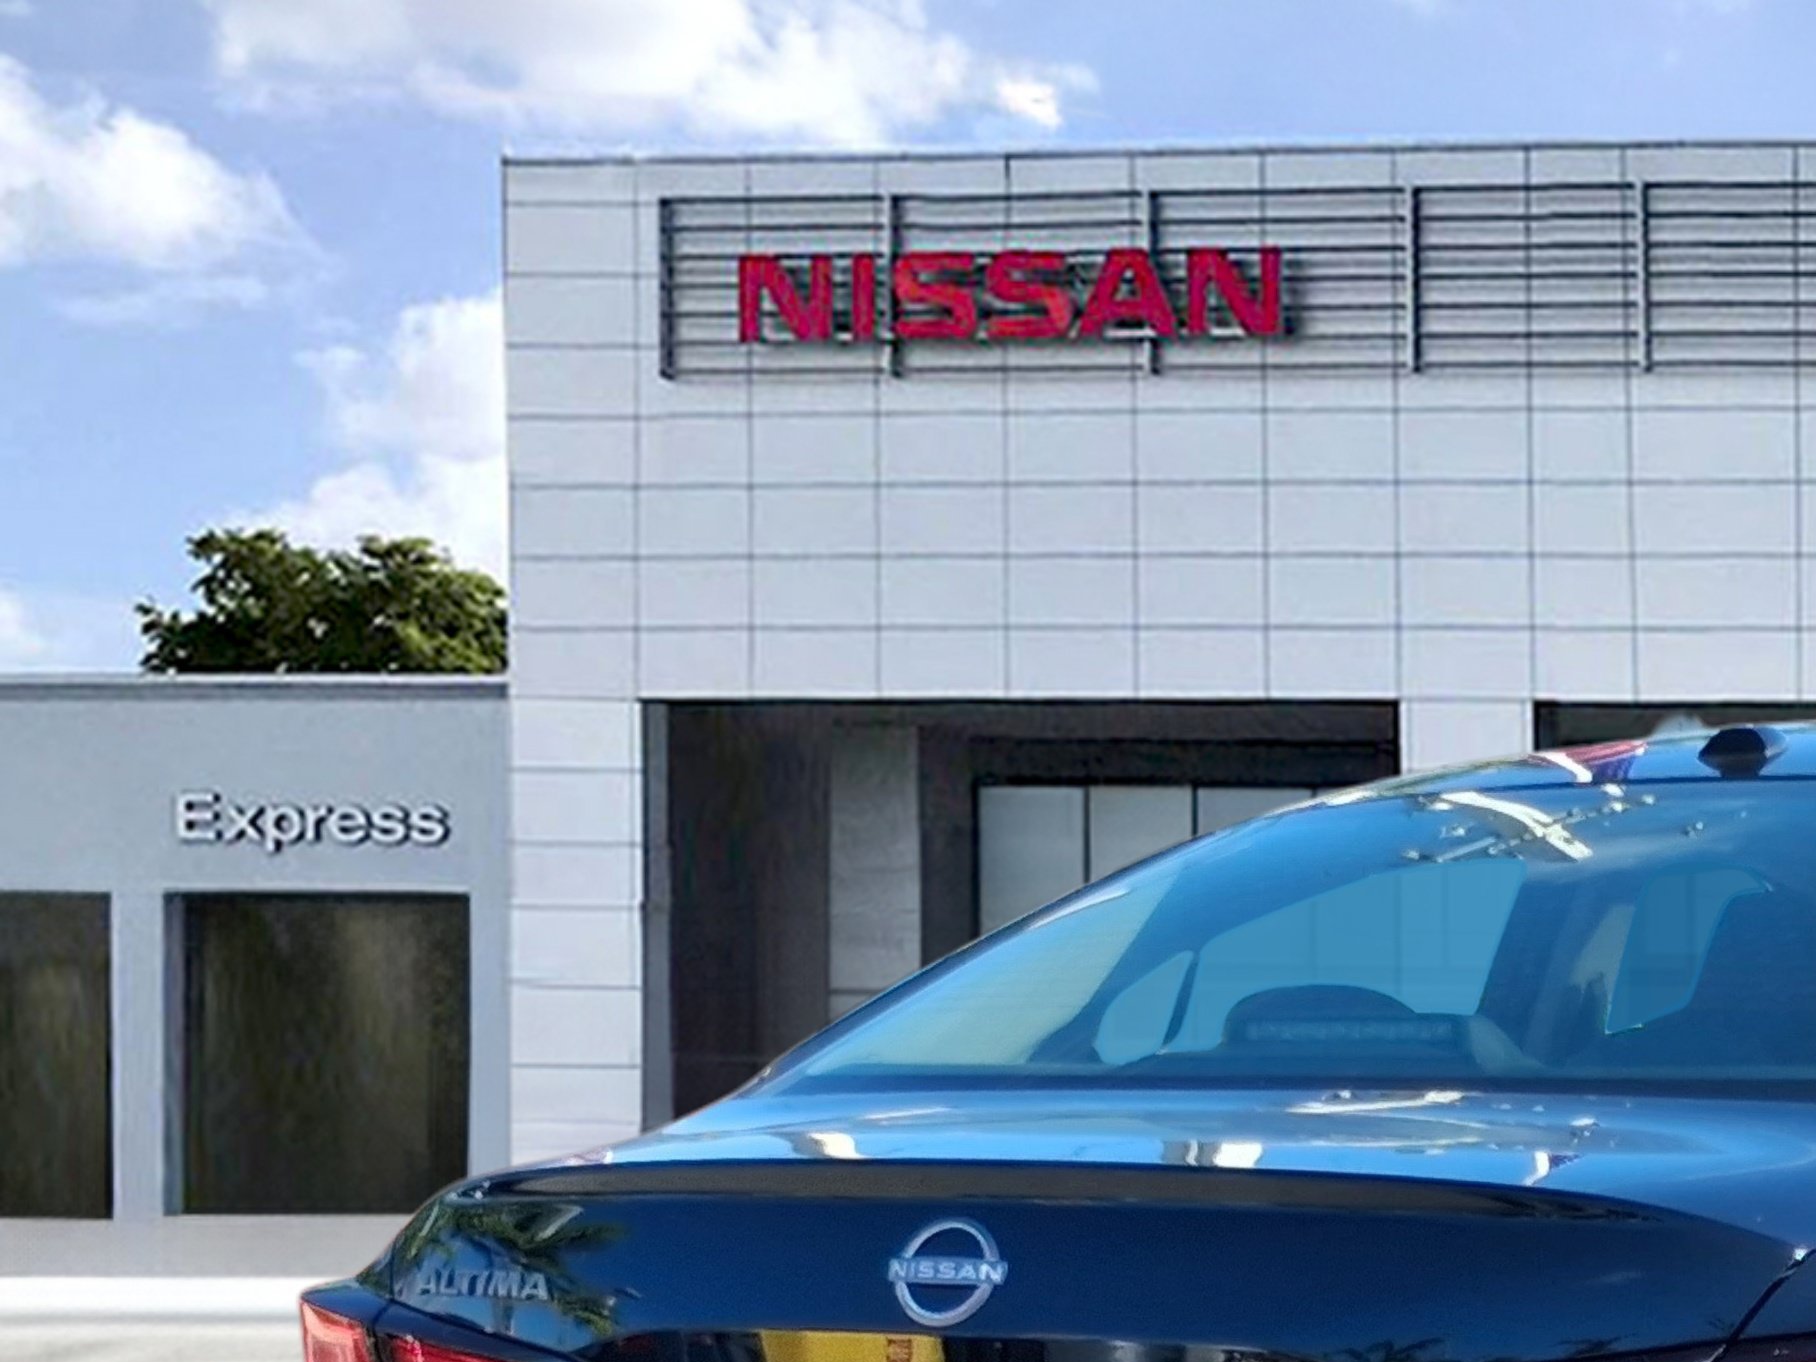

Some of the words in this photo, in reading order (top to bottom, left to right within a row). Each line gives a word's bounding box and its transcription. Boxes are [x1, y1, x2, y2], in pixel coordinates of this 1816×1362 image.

[738, 247, 1282, 344] NISSAN
[177, 791, 451, 854] Express
[416, 1268, 550, 1300] ALTIMA
[889, 1259, 1005, 1282] NISSAN
